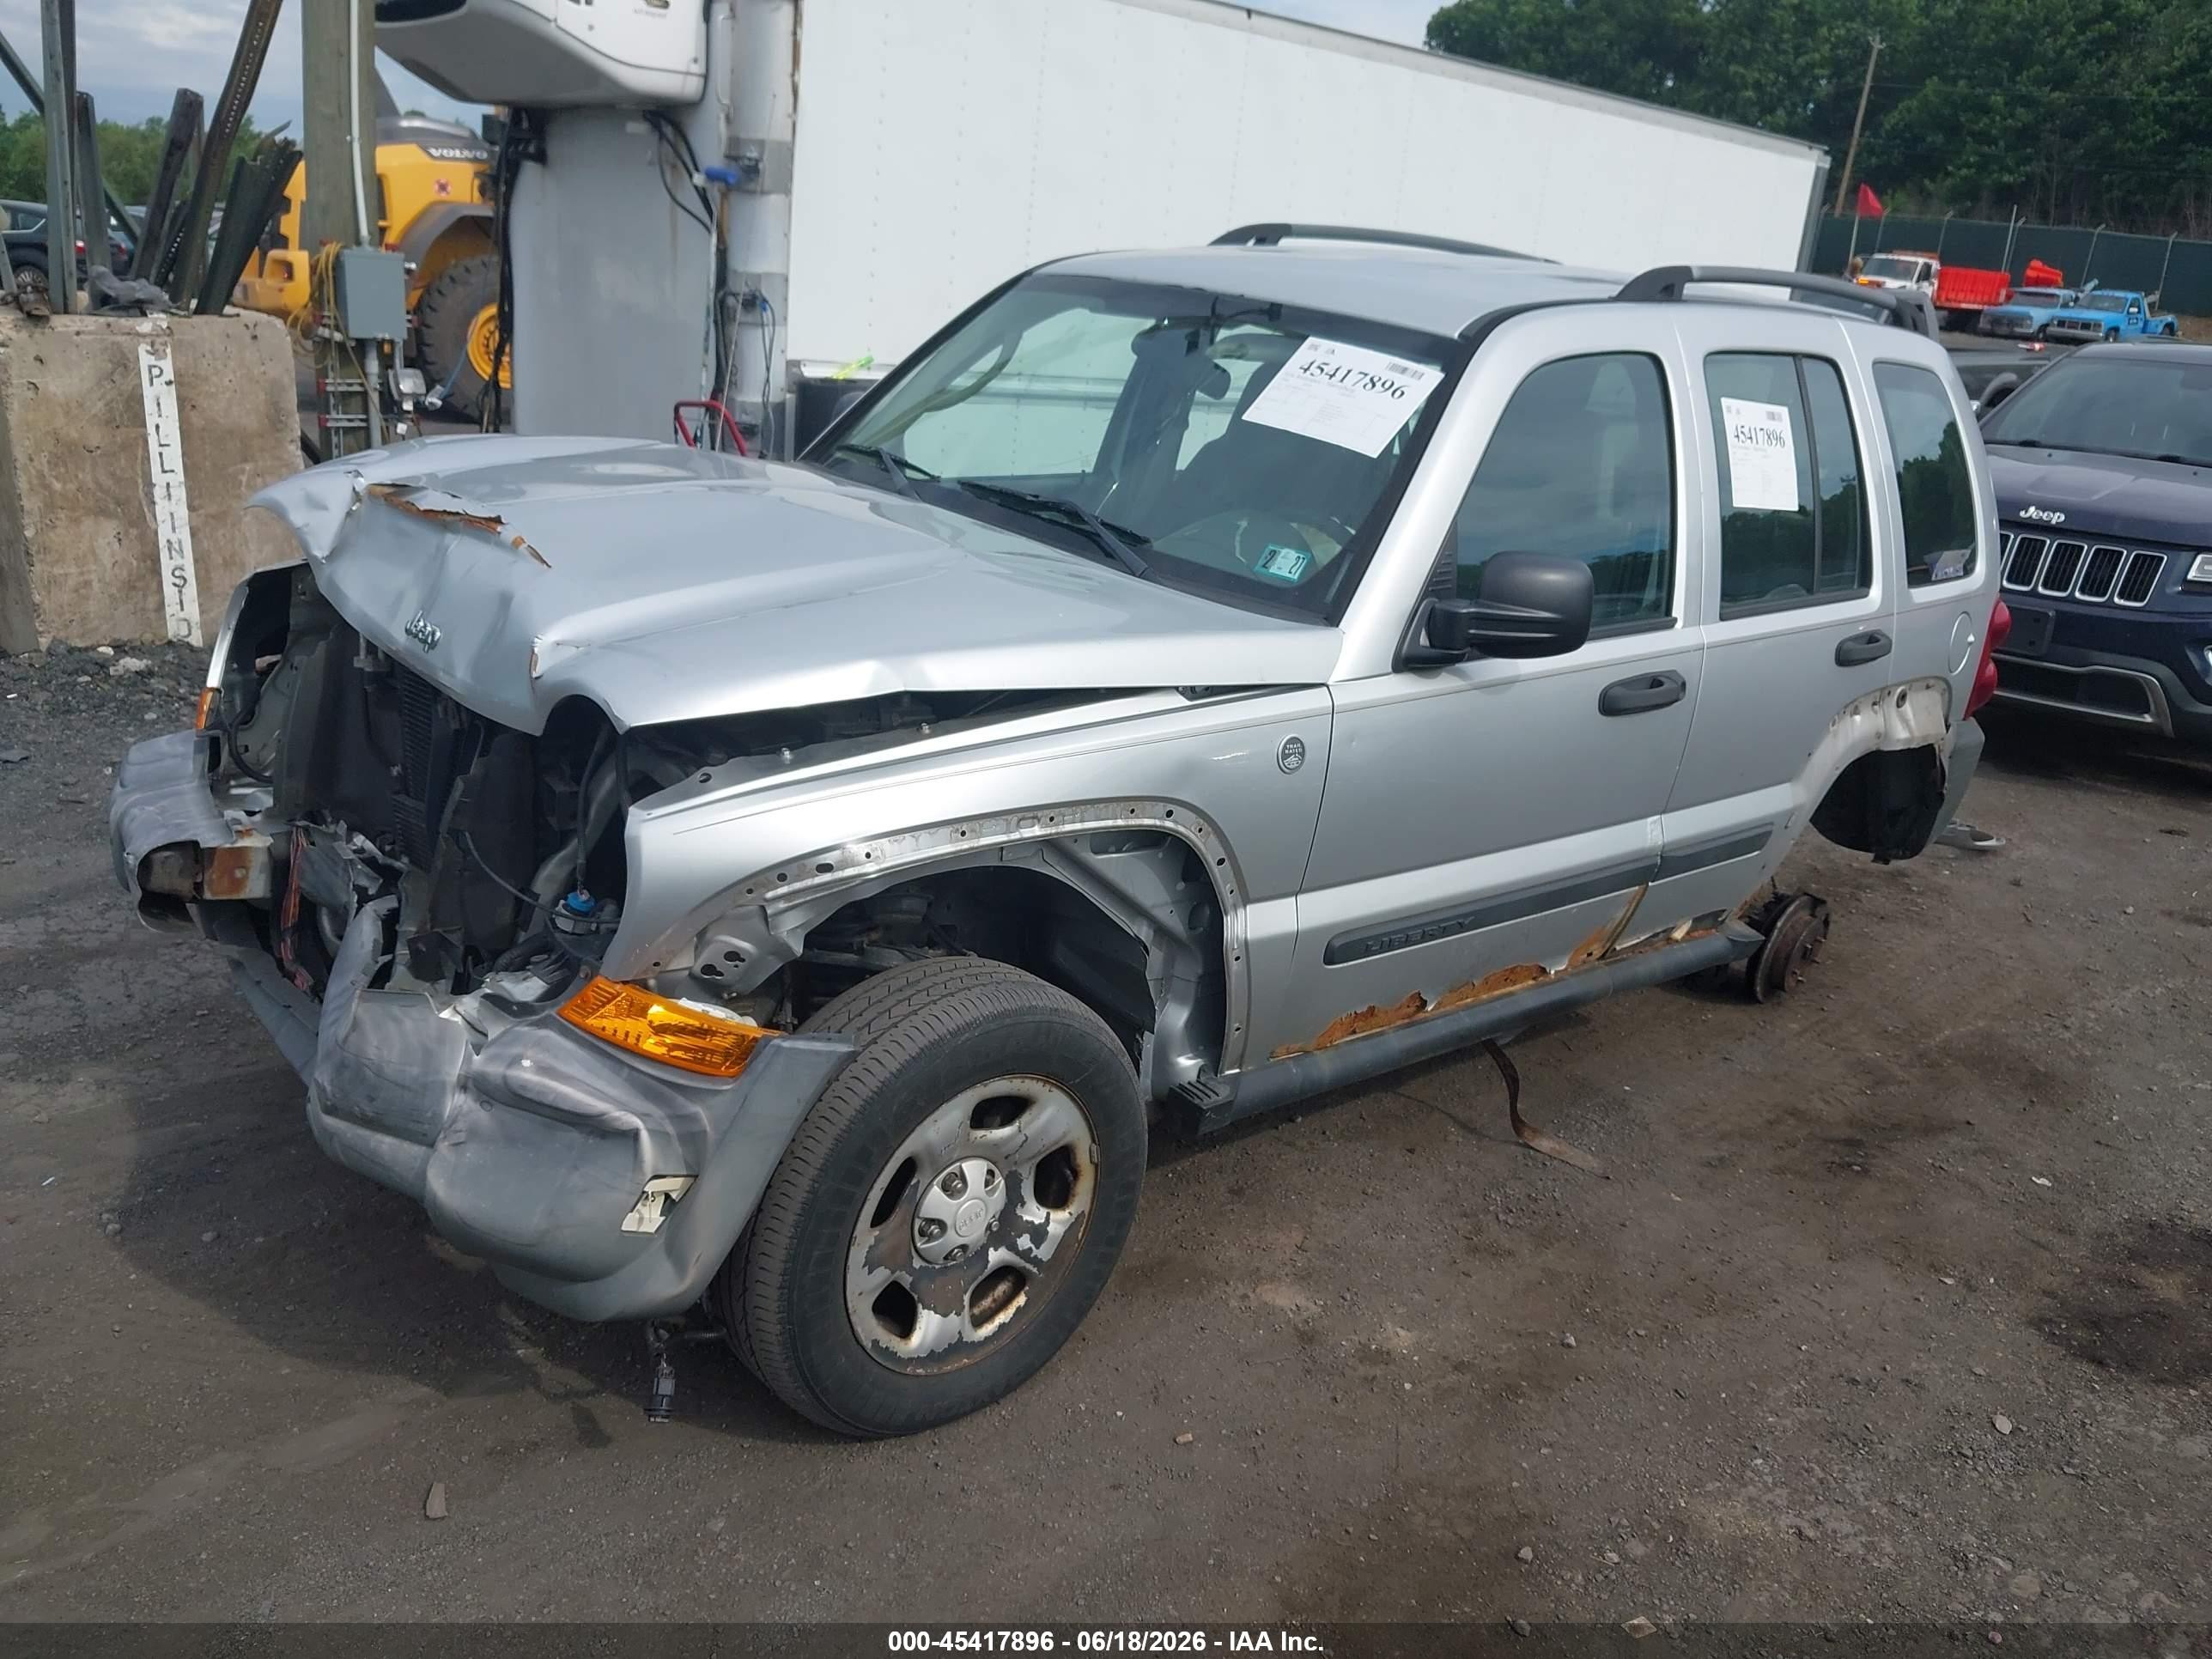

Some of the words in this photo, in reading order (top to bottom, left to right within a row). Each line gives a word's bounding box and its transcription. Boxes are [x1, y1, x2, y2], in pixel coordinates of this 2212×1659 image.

[428, 147, 489, 160] VOLVO
[1298, 359, 1408, 399] 45417896
[1734, 424, 1786, 448] 45417896
[2019, 505, 2066, 525] Jeep
[1288, 556, 1306, 576] 27
[404, 610, 441, 653] Jeep
[1362, 915, 1475, 953] LIBERTY
